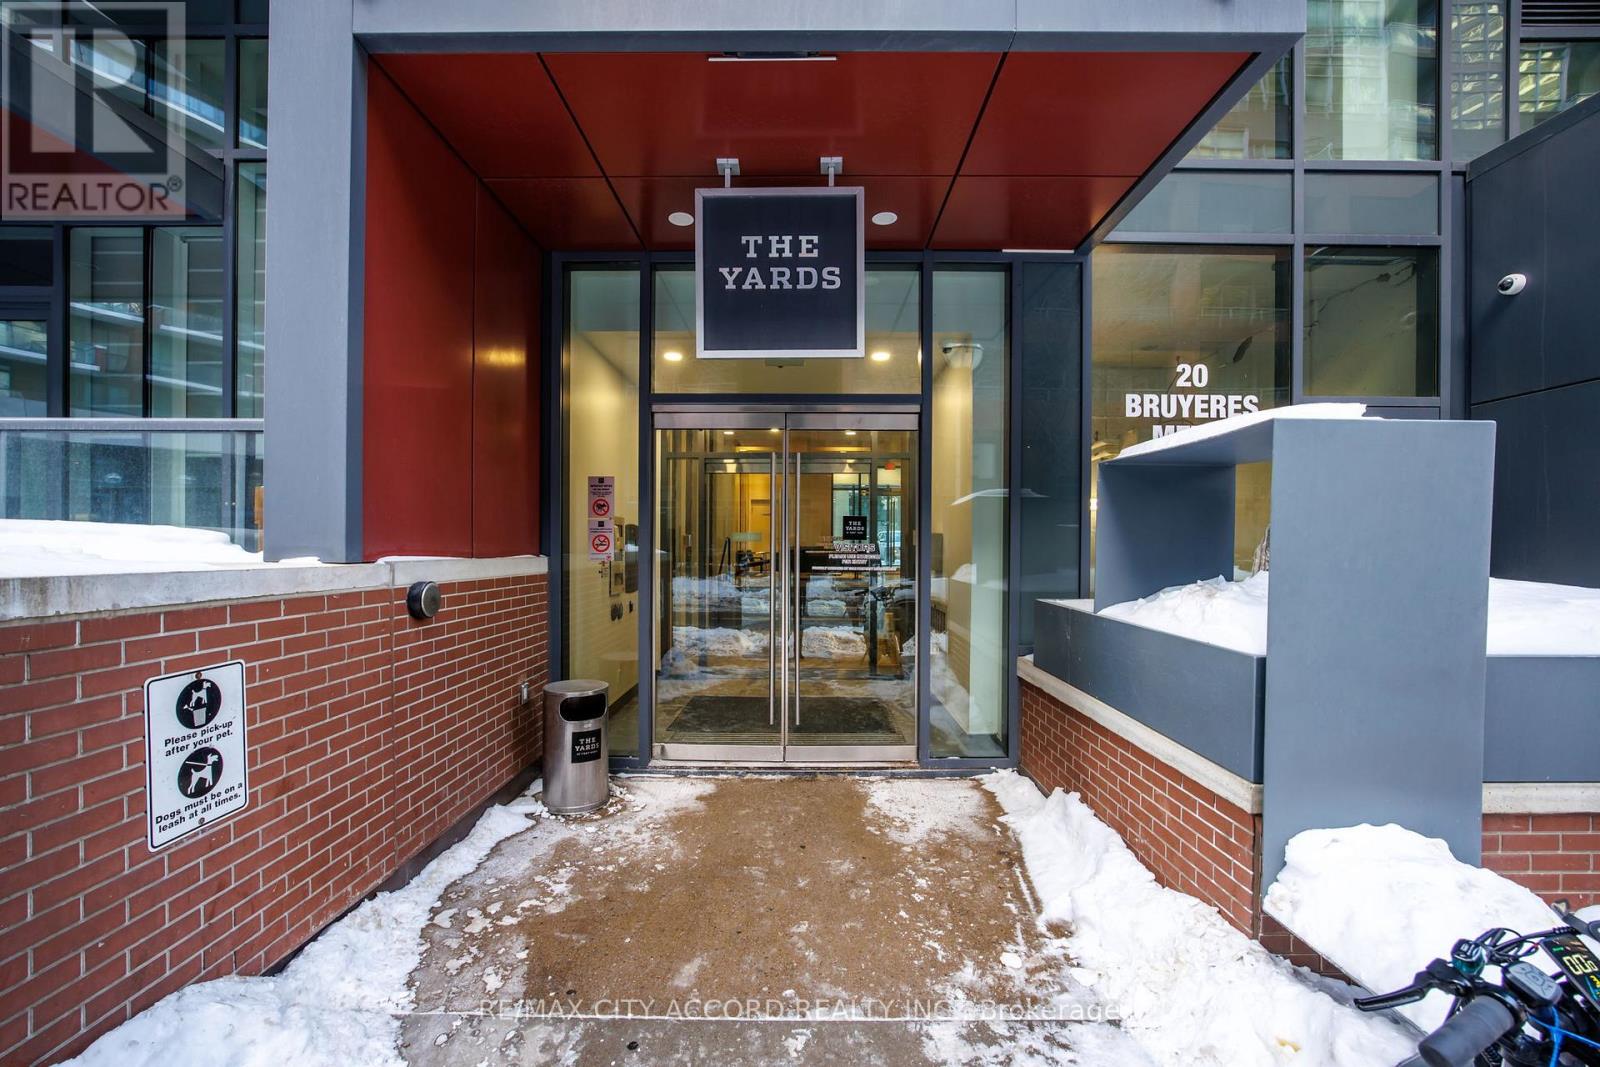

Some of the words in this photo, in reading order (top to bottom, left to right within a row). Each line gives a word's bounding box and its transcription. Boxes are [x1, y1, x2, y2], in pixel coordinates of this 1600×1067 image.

[741, 235, 819, 258] THE
[718, 266, 842, 290] YARDS
[1176, 363, 1209, 388] 20
[1125, 393, 1260, 419] BRUYERES
[164, 732, 198, 747] Please
[200, 720, 233, 737] pick-up
[165, 743, 190, 757] after
[193, 735, 213, 749] your
[215, 728, 233, 741] pet.
[578, 736, 597, 745] THE
[574, 742, 600, 752] YARDS
[155, 808, 182, 825] Dogs
[184, 796, 208, 812] must
[210, 790, 222, 801] be
[224, 786, 235, 794] on
[158, 815, 186, 834] leash
[188, 809, 199, 819] at
[201, 803, 212, 815] all
[214, 792, 241, 808] times.
